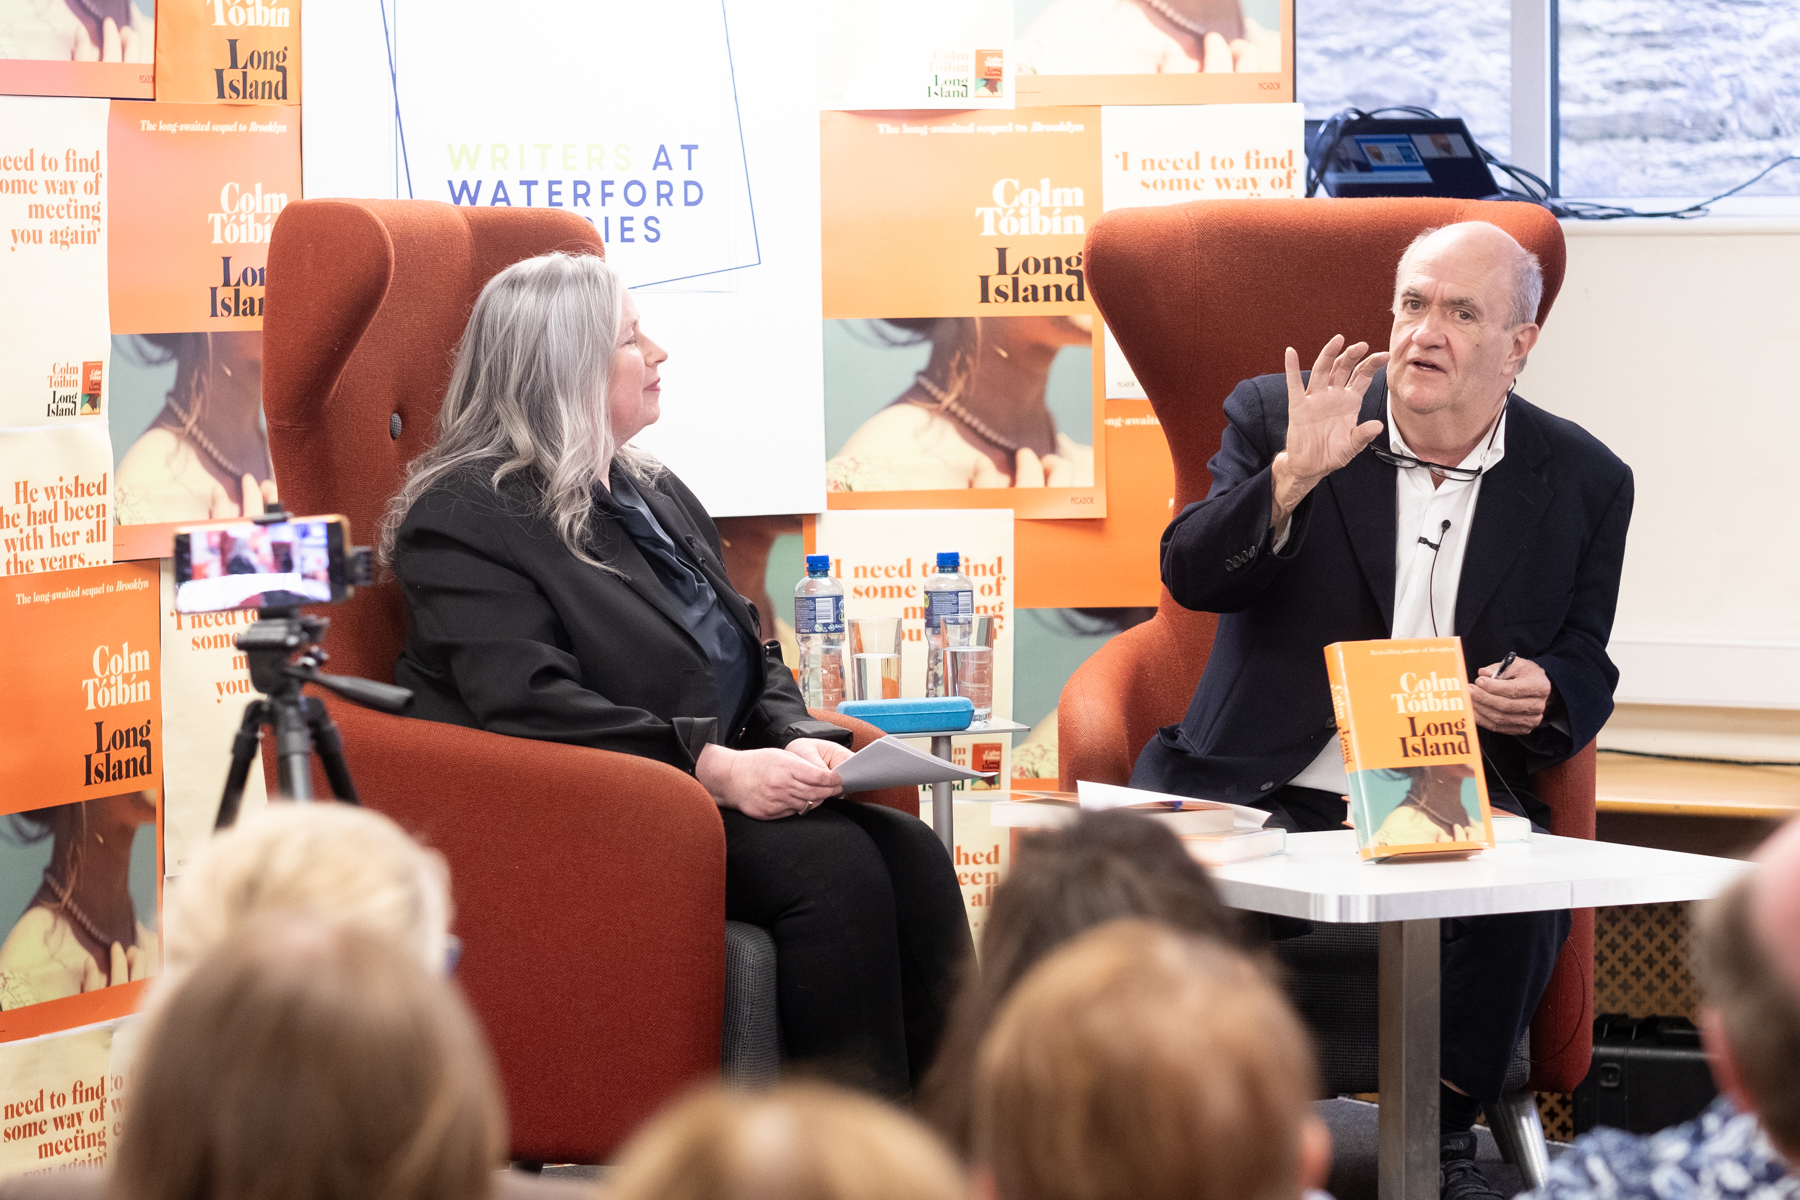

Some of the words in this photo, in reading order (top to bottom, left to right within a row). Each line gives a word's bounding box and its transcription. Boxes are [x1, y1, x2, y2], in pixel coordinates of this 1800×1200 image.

[206, 0, 289, 27] Tóibín
[225, 38, 288, 73] Long
[213, 67, 288, 100] Island
[927, 85, 969, 98] Island
[933, 74, 969, 88] Long
[140, 119, 157, 131] The
[158, 120, 211, 134] long-awaited
[211, 121, 237, 135] sequel
[238, 122, 248, 132] to
[249, 121, 287, 135] Brooklyn
[877, 123, 900, 134] The
[902, 122, 975, 136] long-awaited
[976, 122, 1013, 135] sequel
[1015, 123, 1028, 133] to
[1030, 121, 1085, 134] Brooklyn
[0, 147, 35, 172] eed
[41, 152, 59, 172] to
[65, 148, 101, 173] find
[446, 143, 633, 171] WRITERS
[652, 143, 700, 171] AT
[1141, 150, 1201, 171] need
[1210, 154, 1235, 171] to
[1244, 149, 1294, 170] find
[0, 178, 38, 195] ome
[44, 179, 78, 202] way
[83, 171, 103, 196] of
[220, 181, 289, 214] Colm
[447, 179, 705, 208] WATERFORD
[991, 176, 1086, 209] Colm
[1139, 178, 1206, 192] some
[1214, 177, 1262, 199] way
[1269, 169, 1298, 190] of
[28, 199, 102, 227] meeting
[974, 205, 1086, 236] Tóibín
[10, 228, 43, 252] you
[207, 212, 277, 244] Tóibí
[584, 215, 661, 244] IES
[219, 255, 266, 288] Lo
[993, 246, 1084, 278] Long
[208, 286, 265, 318] Isla
[977, 274, 1087, 304] Island
[46, 374, 79, 389] Tóibín
[52, 361, 79, 376] Colm
[46, 402, 78, 418] Island
[52, 390, 78, 405] Long
[1104, 414, 1161, 429] ng-awaite
[14, 480, 39, 505] He
[44, 472, 107, 502] wished
[1070, 496, 1095, 505] PICADOR
[0, 505, 21, 530] he
[26, 500, 58, 527] had
[64, 499, 107, 523] been
[4, 526, 44, 554] with
[50, 524, 80, 549] her
[85, 518, 107, 545] all
[5, 551, 35, 576] the
[853, 557, 913, 579] need
[16, 592, 32, 606] The
[33, 585, 81, 605] long-awaited
[81, 582, 105, 598] sequel
[106, 583, 114, 593] to
[115, 577, 150, 593] Brooklyn
[852, 584, 917, 599] some
[979, 575, 1007, 598] of
[190, 609, 237, 630] need
[243, 608, 260, 625] to
[92, 641, 151, 679] Colm
[81, 672, 152, 711] Tóibín
[215, 678, 250, 704] you
[1400, 670, 1462, 694] Colm
[1390, 687, 1465, 714] Tóibín
[94, 719, 152, 755] Long
[1406, 715, 1467, 738] Long
[1399, 733, 1472, 758] Island
[83, 747, 153, 787] Island
[4, 1088, 45, 1121] need
[50, 1090, 67, 1109] to
[72, 1075, 106, 1106] find
[3, 1118, 48, 1144] some
[53, 1110, 84, 1134] way
[89, 1096, 108, 1124] of
[38, 1126, 108, 1160] meeting
